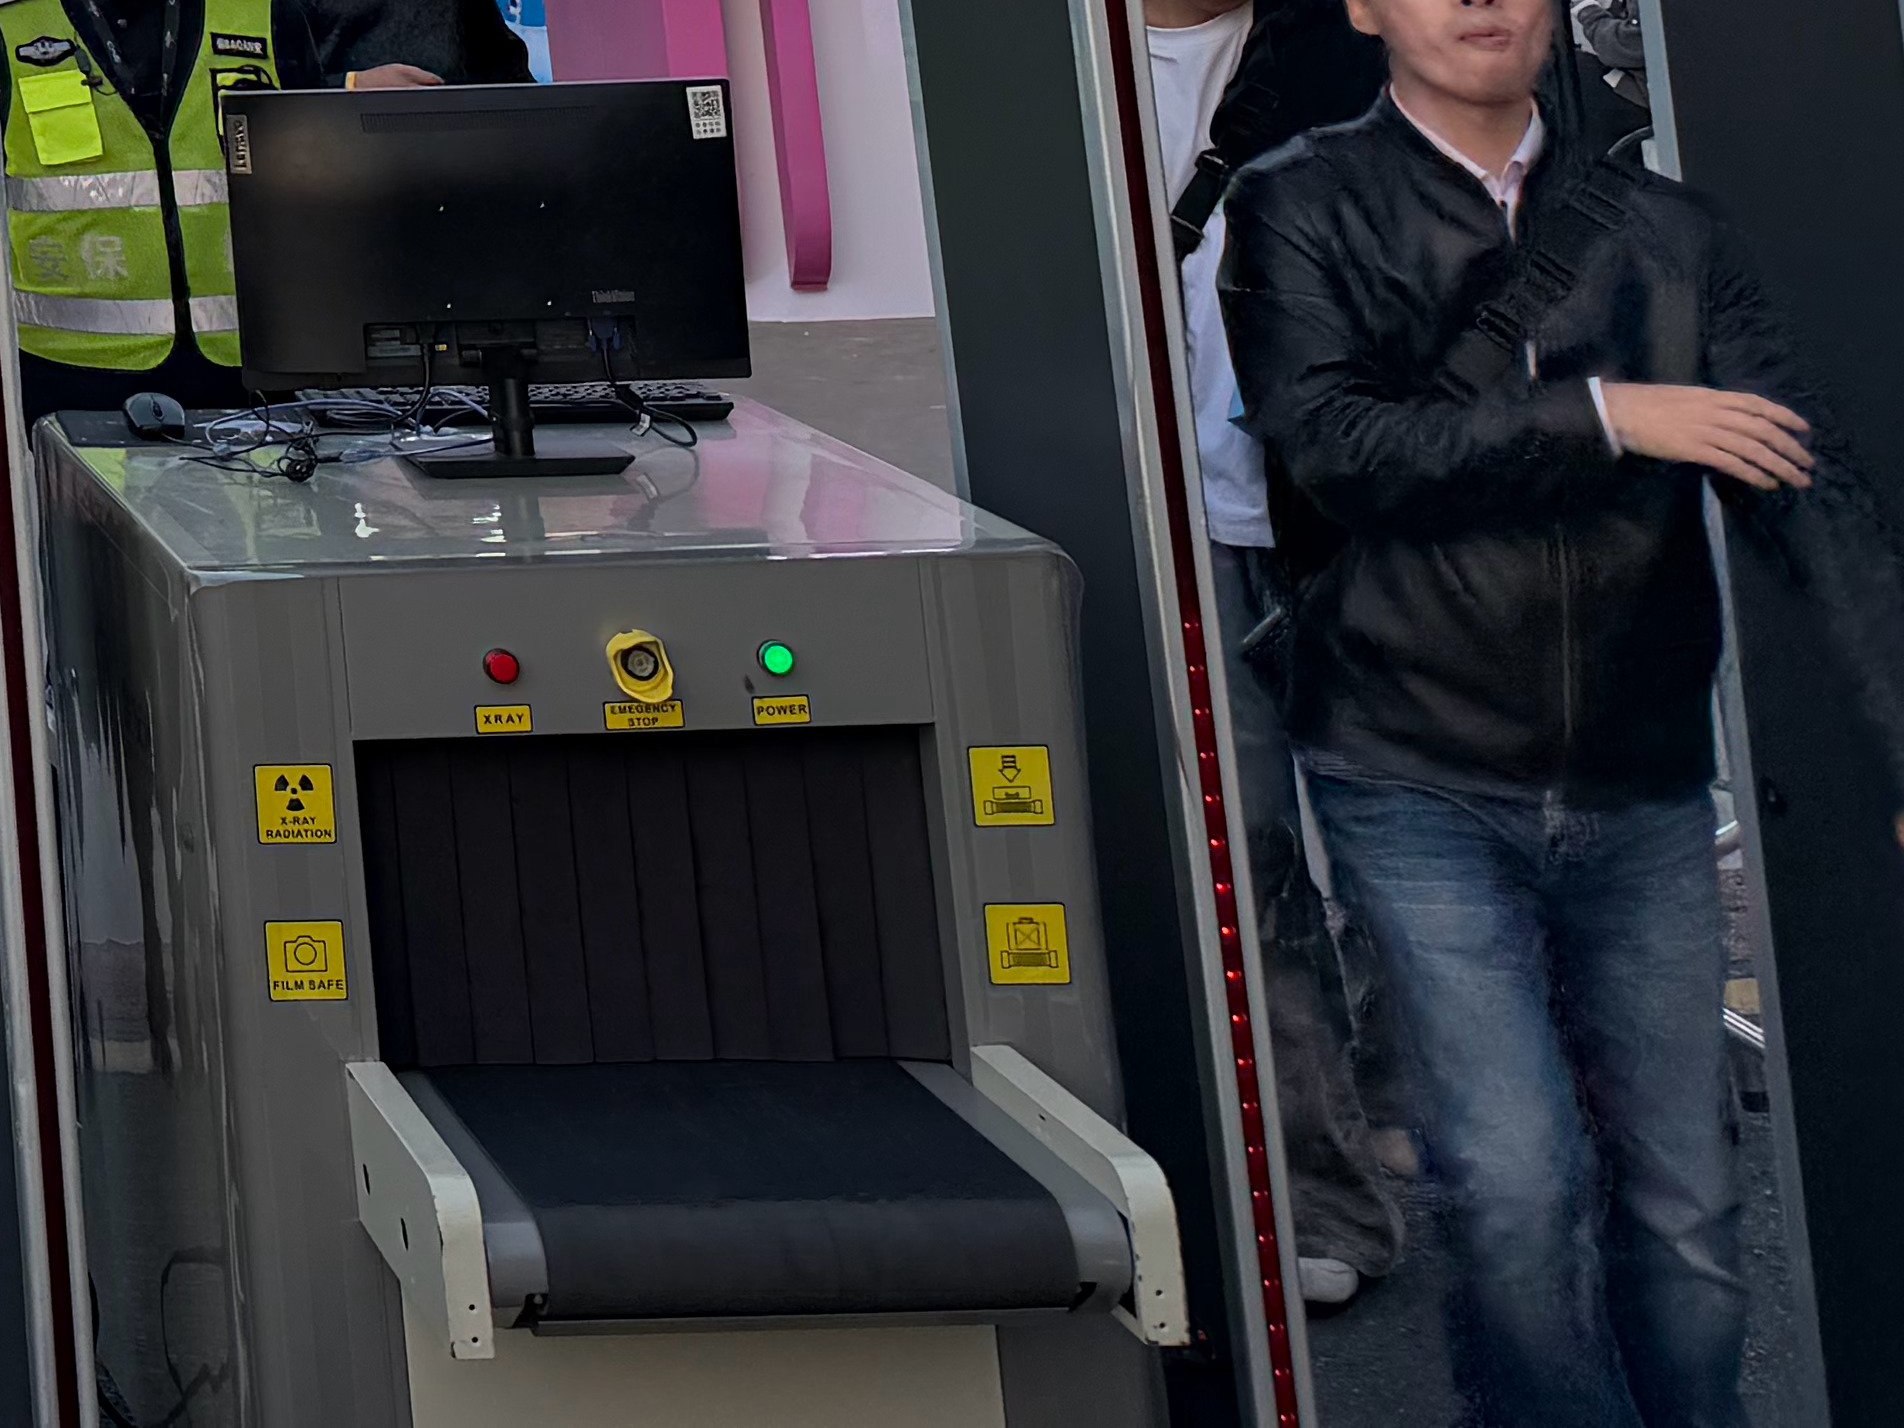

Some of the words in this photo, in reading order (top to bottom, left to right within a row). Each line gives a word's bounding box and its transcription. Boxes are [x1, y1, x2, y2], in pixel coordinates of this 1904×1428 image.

[757, 703, 809, 717] POWER
[482, 713, 526, 725] XRAY
[627, 716, 660, 728] STOP
[279, 815, 317, 826] X-RAY
[265, 828, 332, 840] RADIATION
[272, 980, 305, 992] FILM
[309, 979, 345, 991] SAFE
